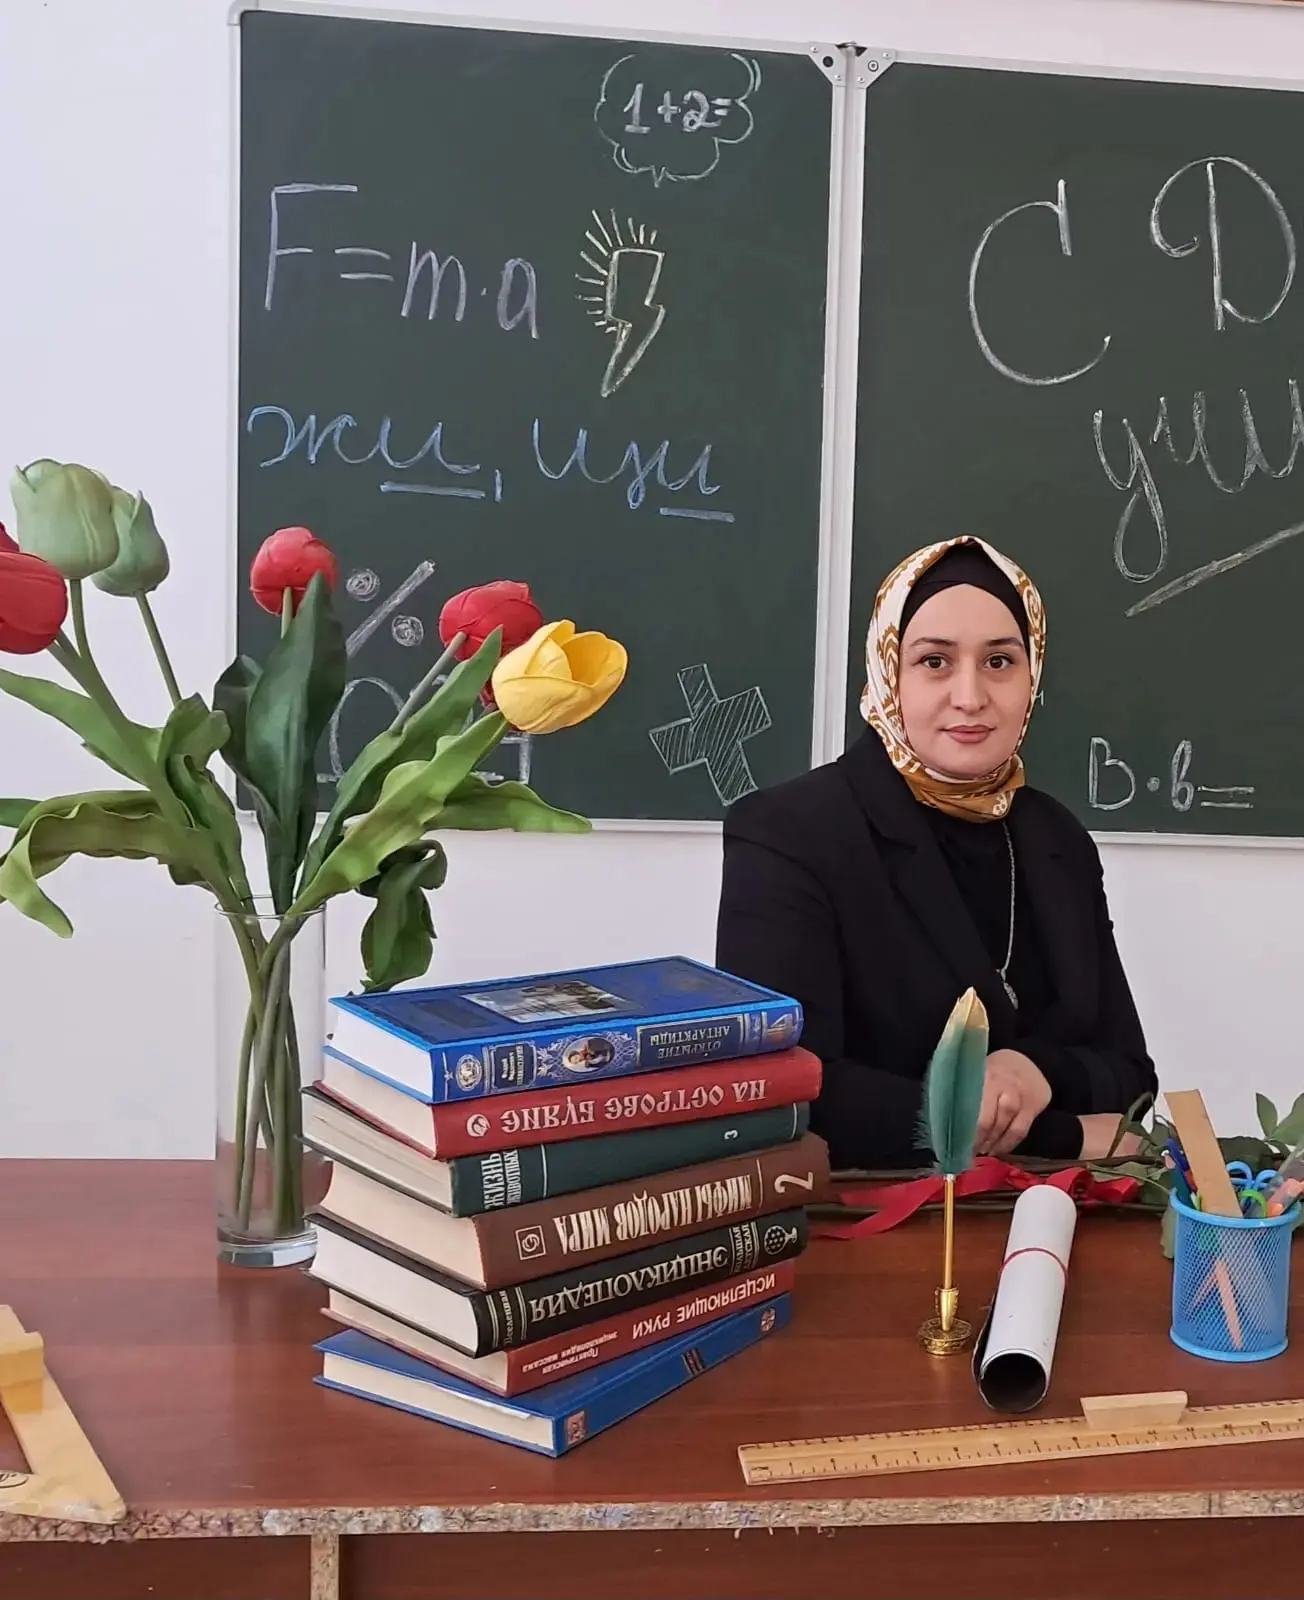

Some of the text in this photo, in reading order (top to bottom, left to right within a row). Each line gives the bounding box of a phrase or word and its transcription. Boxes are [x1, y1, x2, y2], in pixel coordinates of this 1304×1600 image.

[650, 1025, 730, 1046] АНТАРКТИДЫ
[658, 1040, 722, 1059] ОТКРЫТИЕ
[501, 1079, 766, 1134] НА ОСТРОВЕ БУЯНЕ
[724, 1129, 739, 1141] 3
[481, 1152, 505, 1210] ЖИЗНЬ
[503, 1149, 522, 1204] ЖИВОТНЫХ
[774, 1171, 814, 1194] 2
[553, 1174, 752, 1256] МИФЫ НАРОДОВ МИРА
[530, 1246, 728, 1322] ЭНЦИКЛОПЕДИЯ
[632, 1273, 776, 1340] ИСЦЕЛЯЮЩИЕ РУКИ
